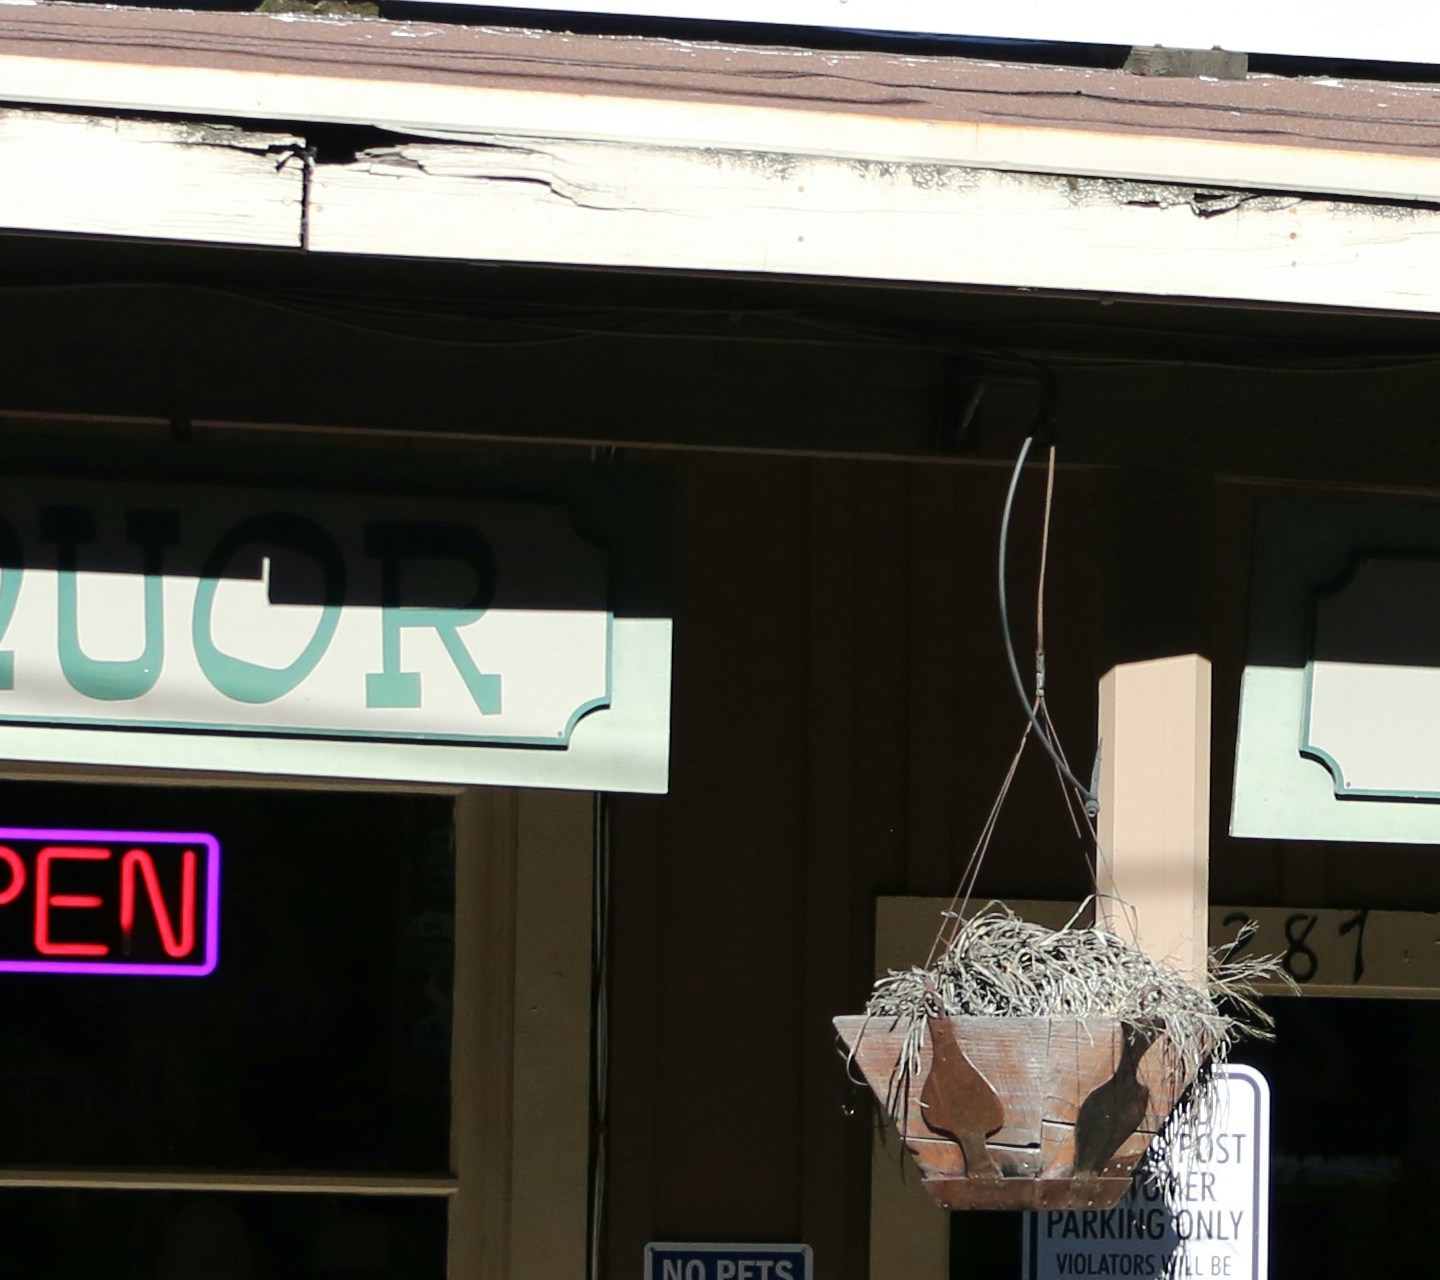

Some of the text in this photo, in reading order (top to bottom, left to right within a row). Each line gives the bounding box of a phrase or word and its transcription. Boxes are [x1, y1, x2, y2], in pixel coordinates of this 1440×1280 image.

[1047, 1209, 1244, 1240] PARKING ONLY
[1057, 1253, 1232, 1276] VIOLATORS WILL BE
